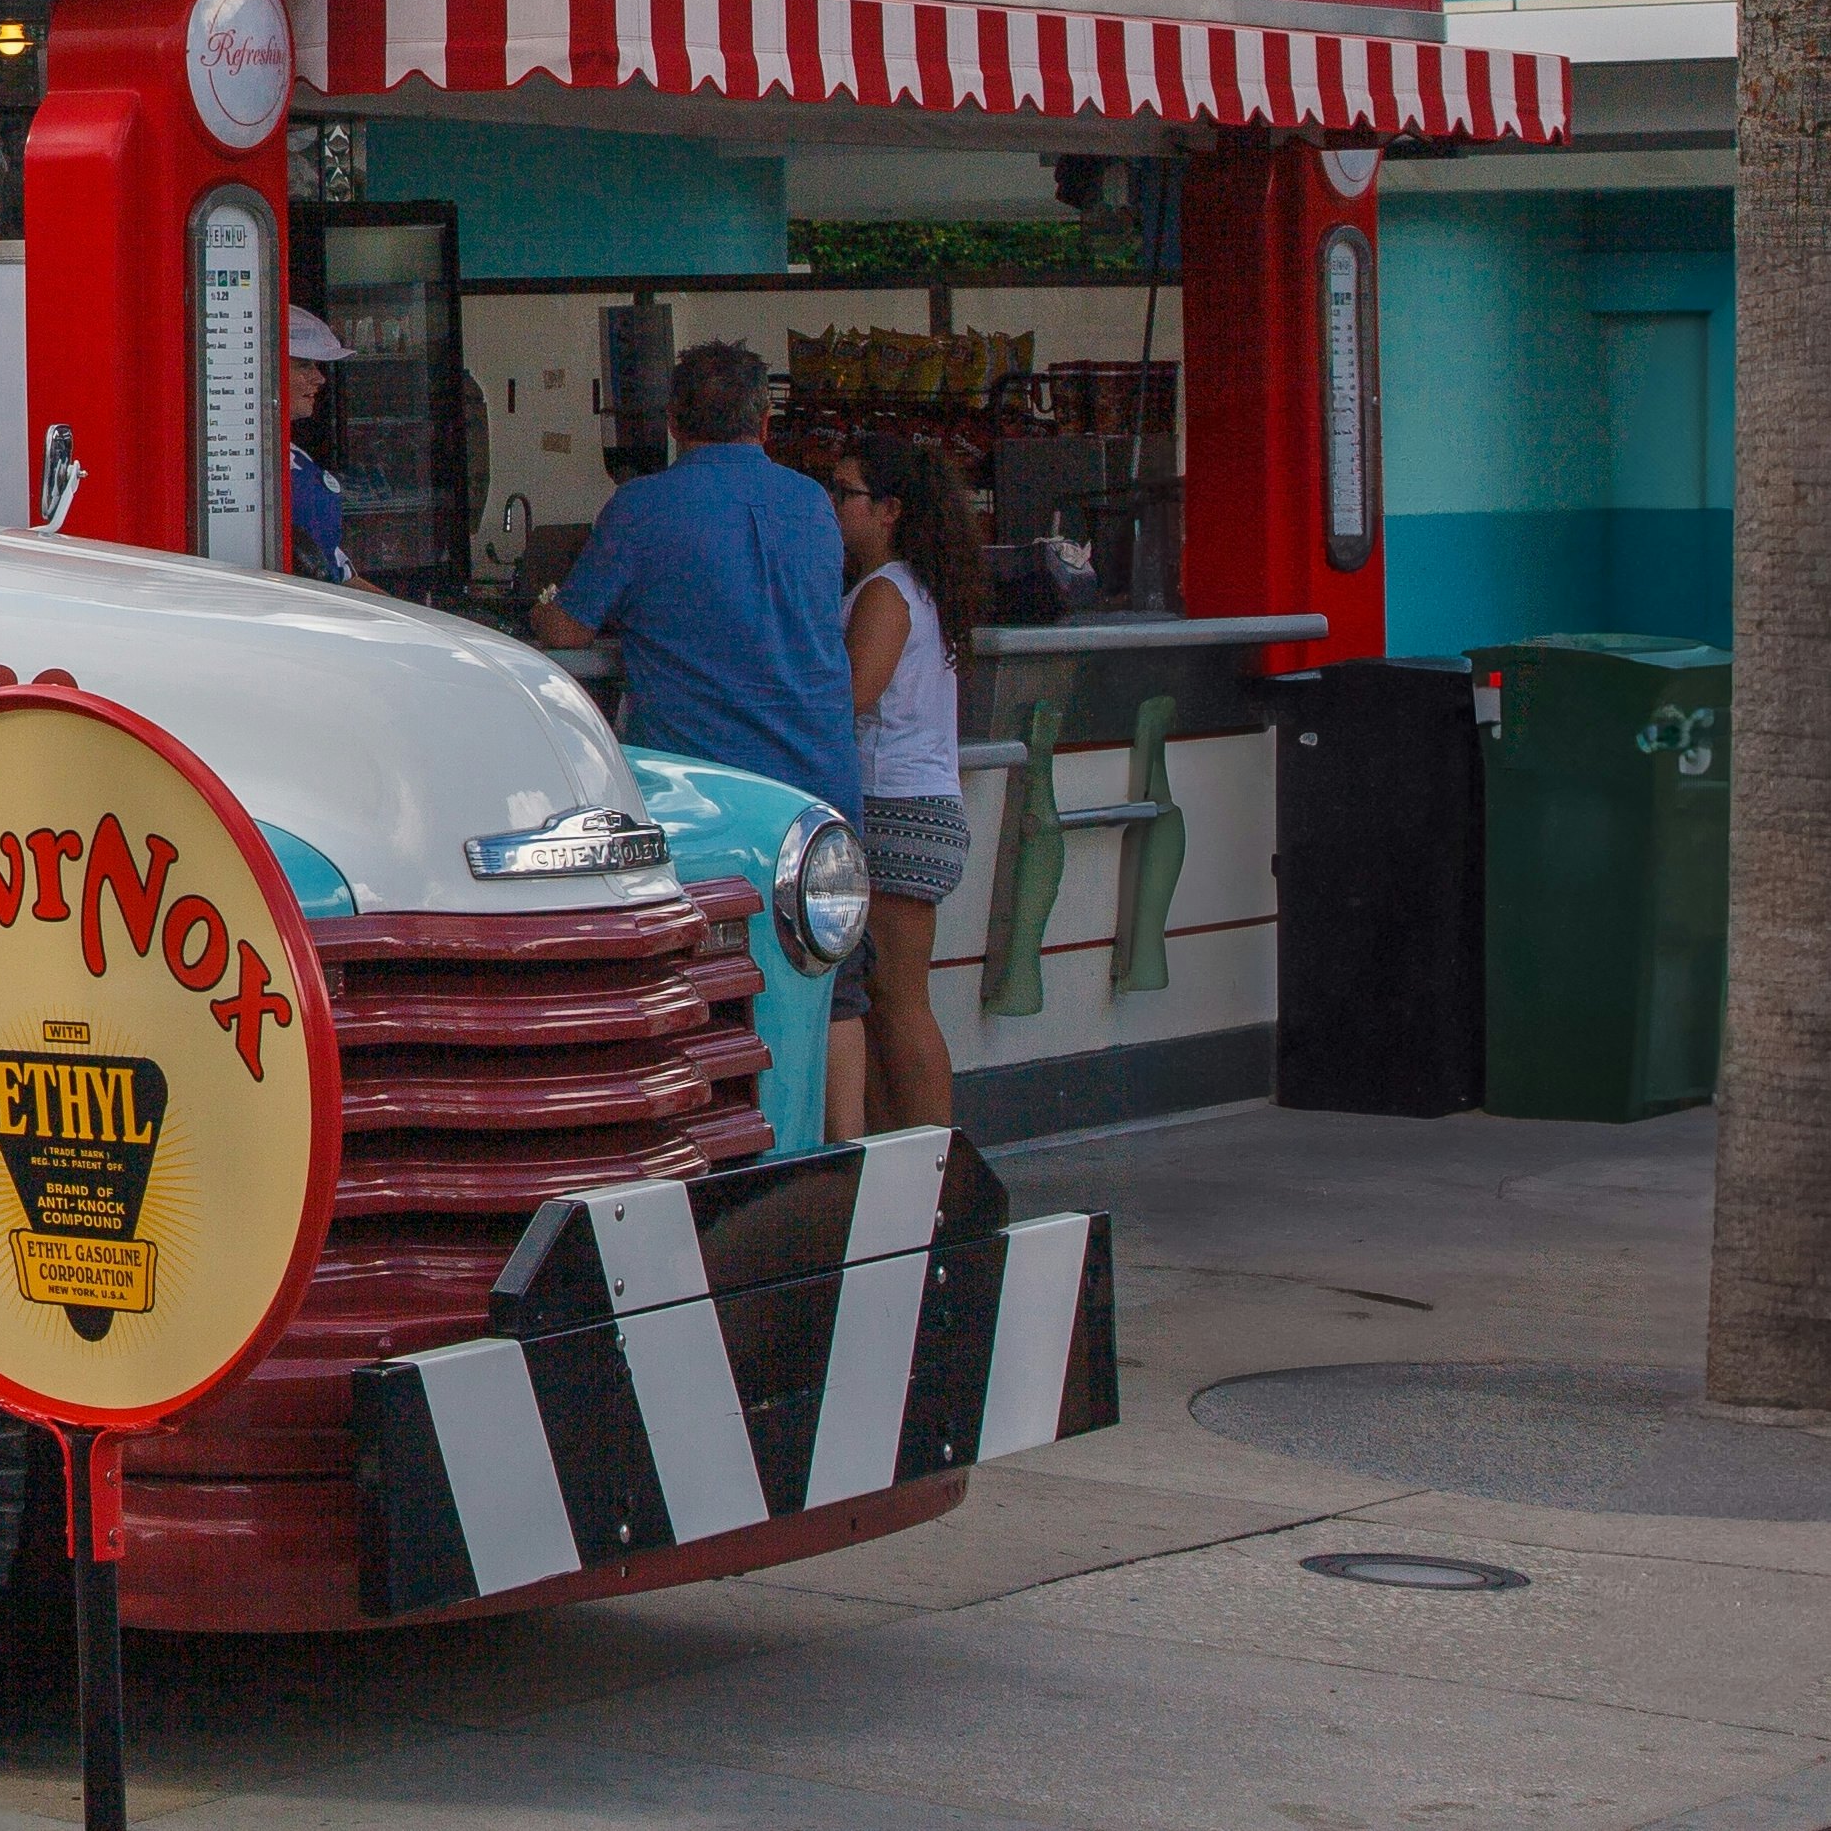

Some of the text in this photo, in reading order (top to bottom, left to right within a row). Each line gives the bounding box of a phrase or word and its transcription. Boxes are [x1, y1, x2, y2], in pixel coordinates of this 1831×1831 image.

[532, 843, 660, 869] CHEVROLET
[49, 1026, 83, 1039] WITH
[71, 1160, 102, 1170] PATENT
[46, 1182, 114, 1198] BRAND OF
[37, 1196, 125, 1215] ANTI-KNOCK
[43, 1212, 122, 1230] COMPOUND
[27, 1240, 142, 1267] ETHYL GASOLINE
[39, 1263, 134, 1288] CORPORATION
[48, 1285, 128, 1302] NEW YORK, U.S.A.
